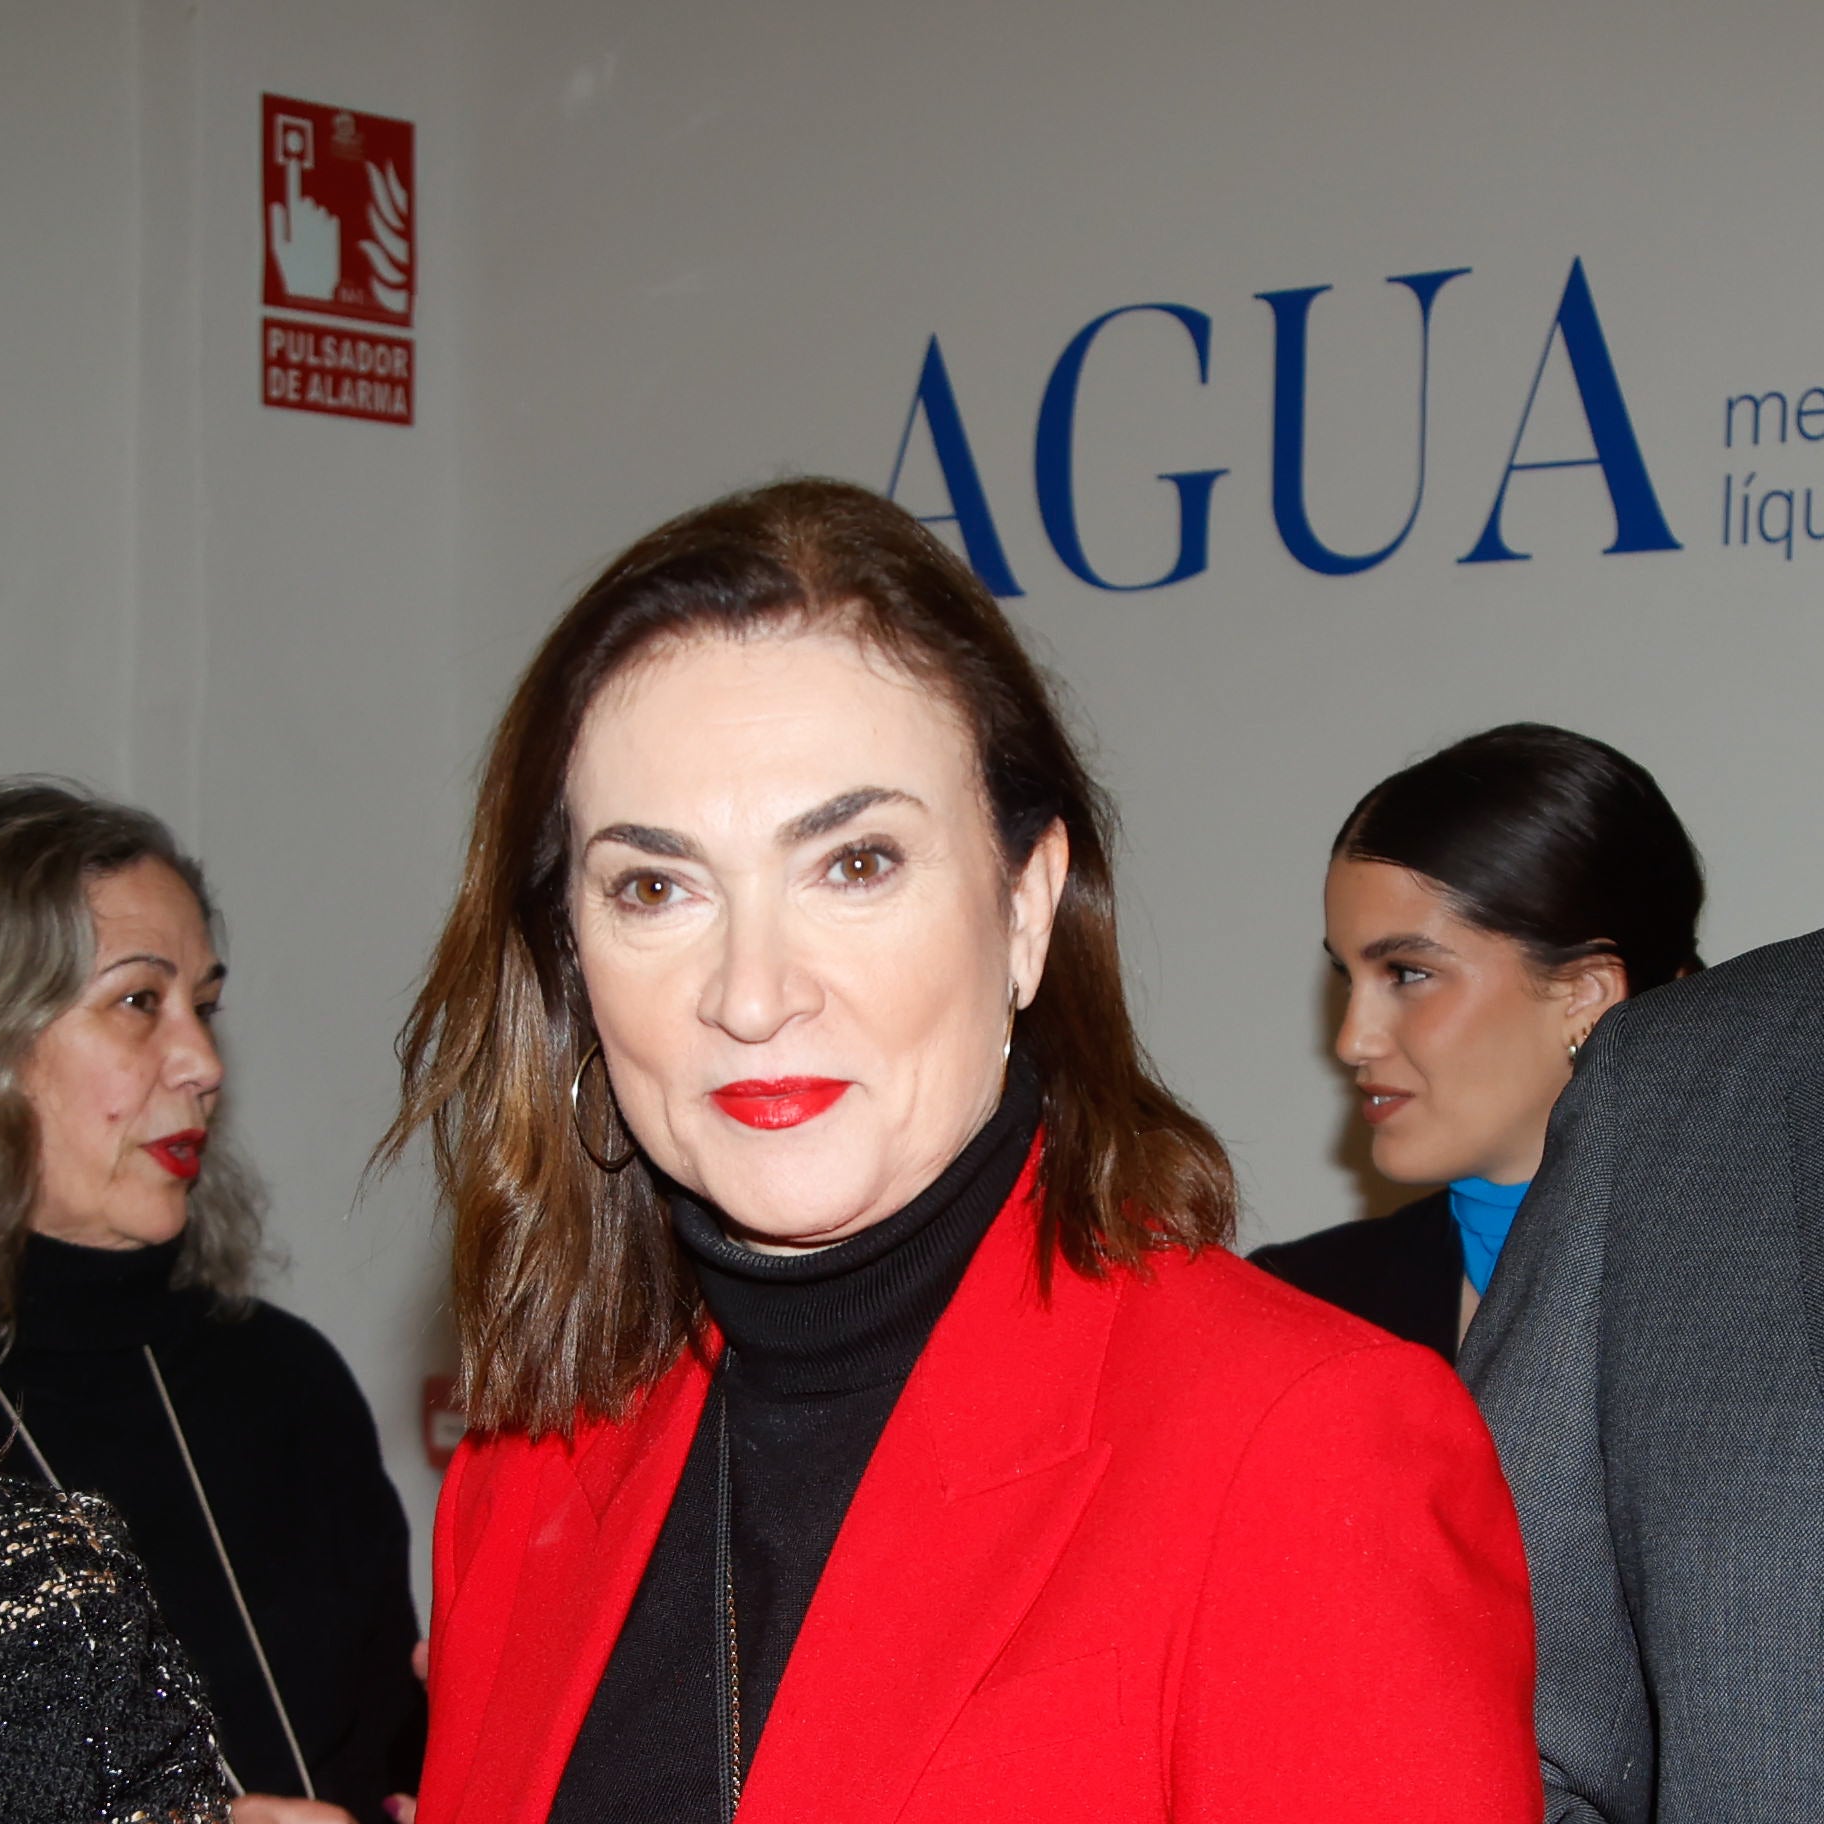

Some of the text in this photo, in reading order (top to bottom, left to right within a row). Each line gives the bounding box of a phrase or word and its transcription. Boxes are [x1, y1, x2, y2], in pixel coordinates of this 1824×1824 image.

[267, 327, 409, 378] PULSADOR
[267, 365, 409, 416] DE ALARMA
[886, 255, 1684, 598] AGUA
